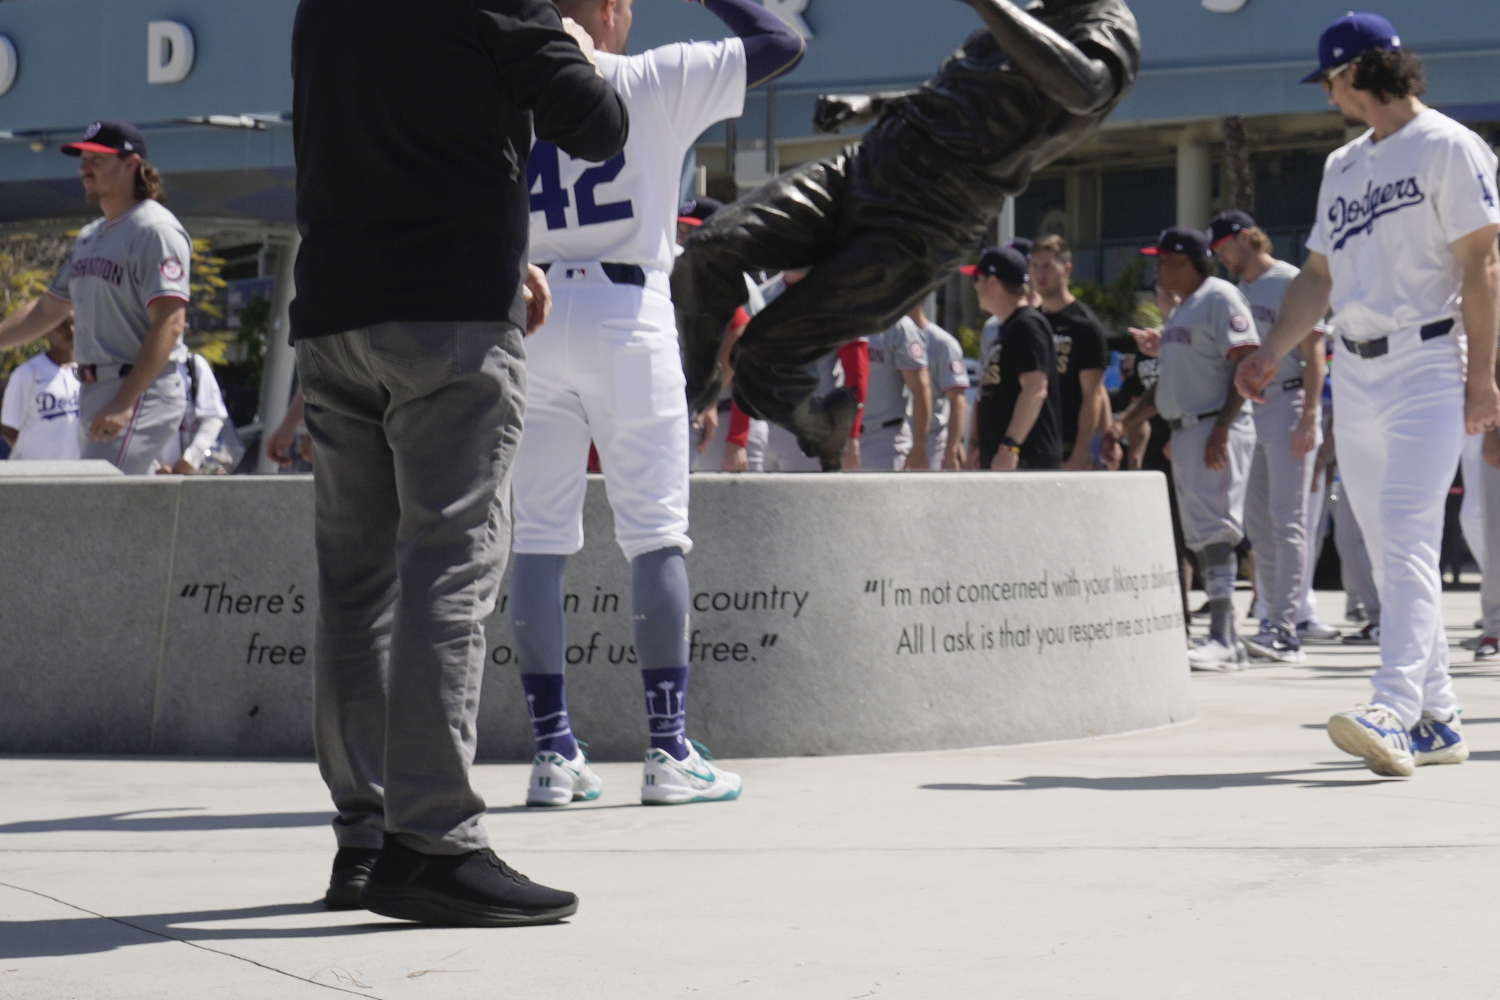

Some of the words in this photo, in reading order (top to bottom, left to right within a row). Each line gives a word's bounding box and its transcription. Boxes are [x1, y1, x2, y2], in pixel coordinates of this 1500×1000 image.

[527, 138, 634, 230] 42
[1328, 176, 1425, 251] Dodgers
[593, 586, 619, 613] in
[693, 585, 810, 618] country
[920, 579, 952, 606] not
[956, 568, 1048, 603] concerned
[1051, 566, 1081, 598] with
[1083, 577, 1110, 604] your
[246, 632, 307, 666] free
[566, 632, 601, 665] of
[896, 622, 924, 655] All
[931, 625, 937, 654] I
[943, 620, 976, 653] ask
[981, 624, 994, 650] is
[1000, 617, 1031, 649] that
[1034, 626, 1066, 655] you
[1068, 617, 1114, 650] respect
